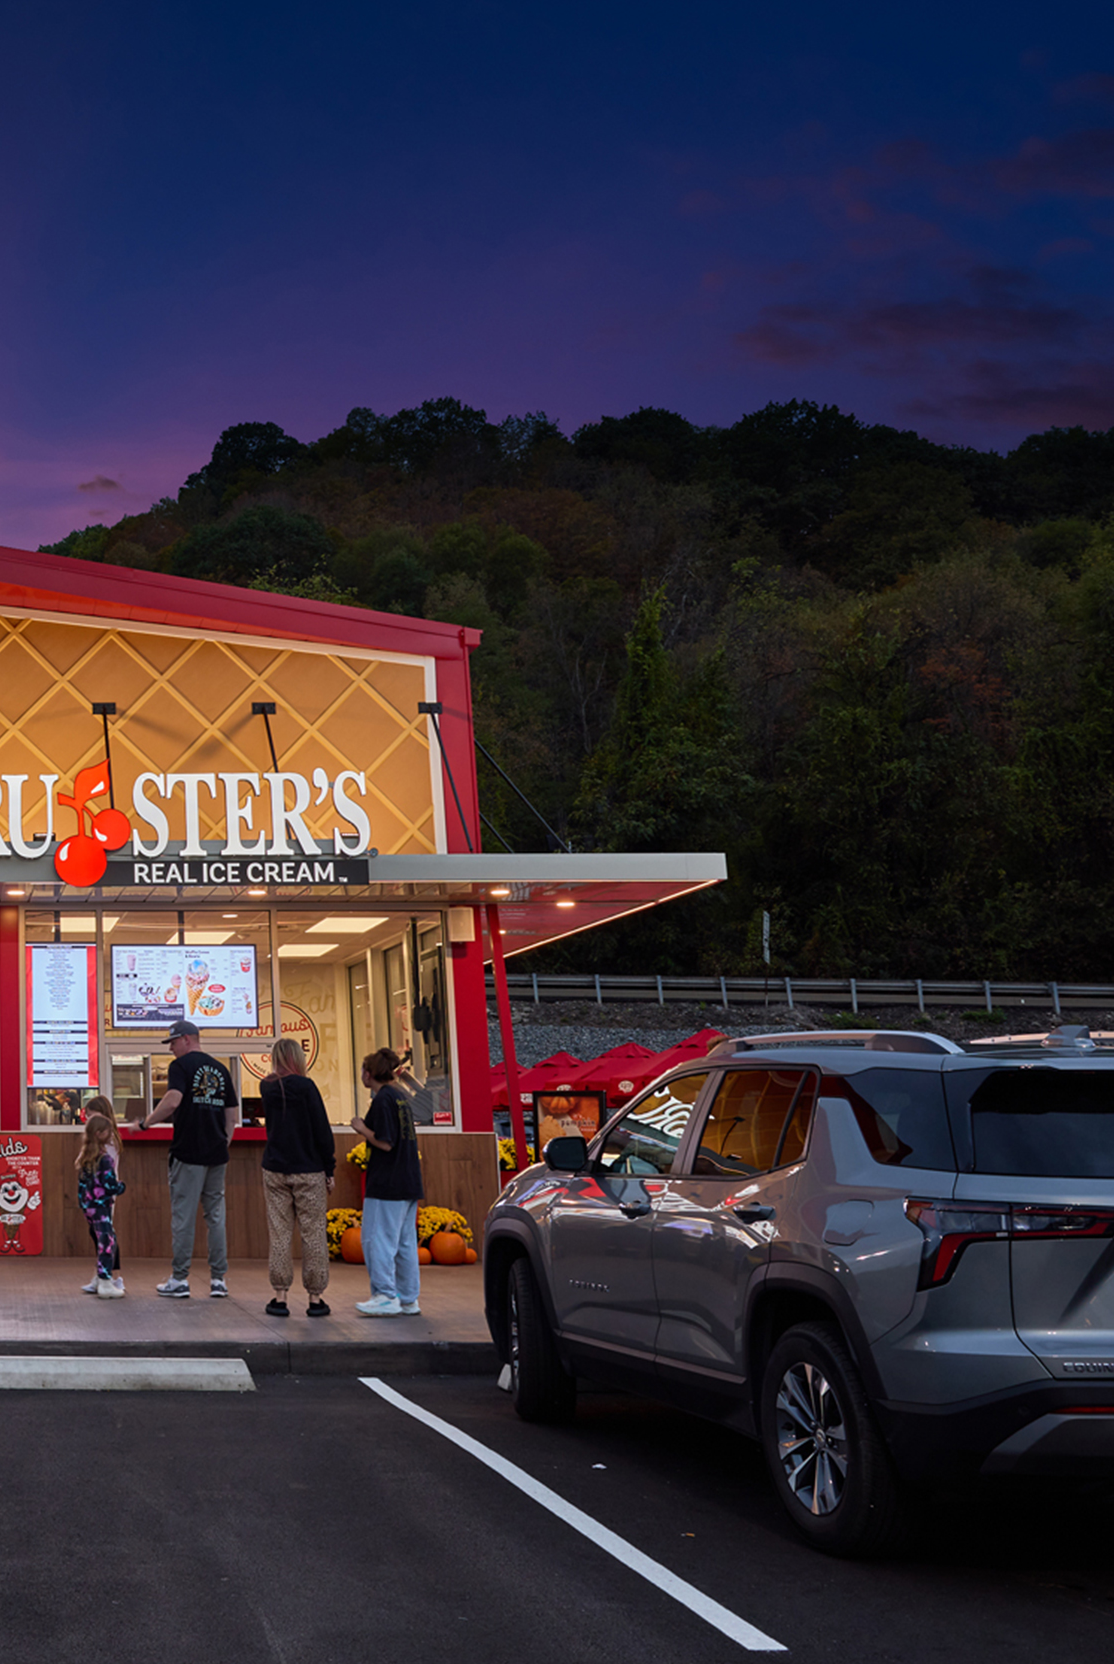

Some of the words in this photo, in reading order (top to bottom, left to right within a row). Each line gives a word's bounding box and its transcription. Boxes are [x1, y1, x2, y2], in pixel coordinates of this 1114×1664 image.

[134, 863, 197, 884] REAL
[202, 862, 241, 883] ICE
[246, 862, 335, 883] CREAM
[561, 1117, 596, 1127] pumpkin
